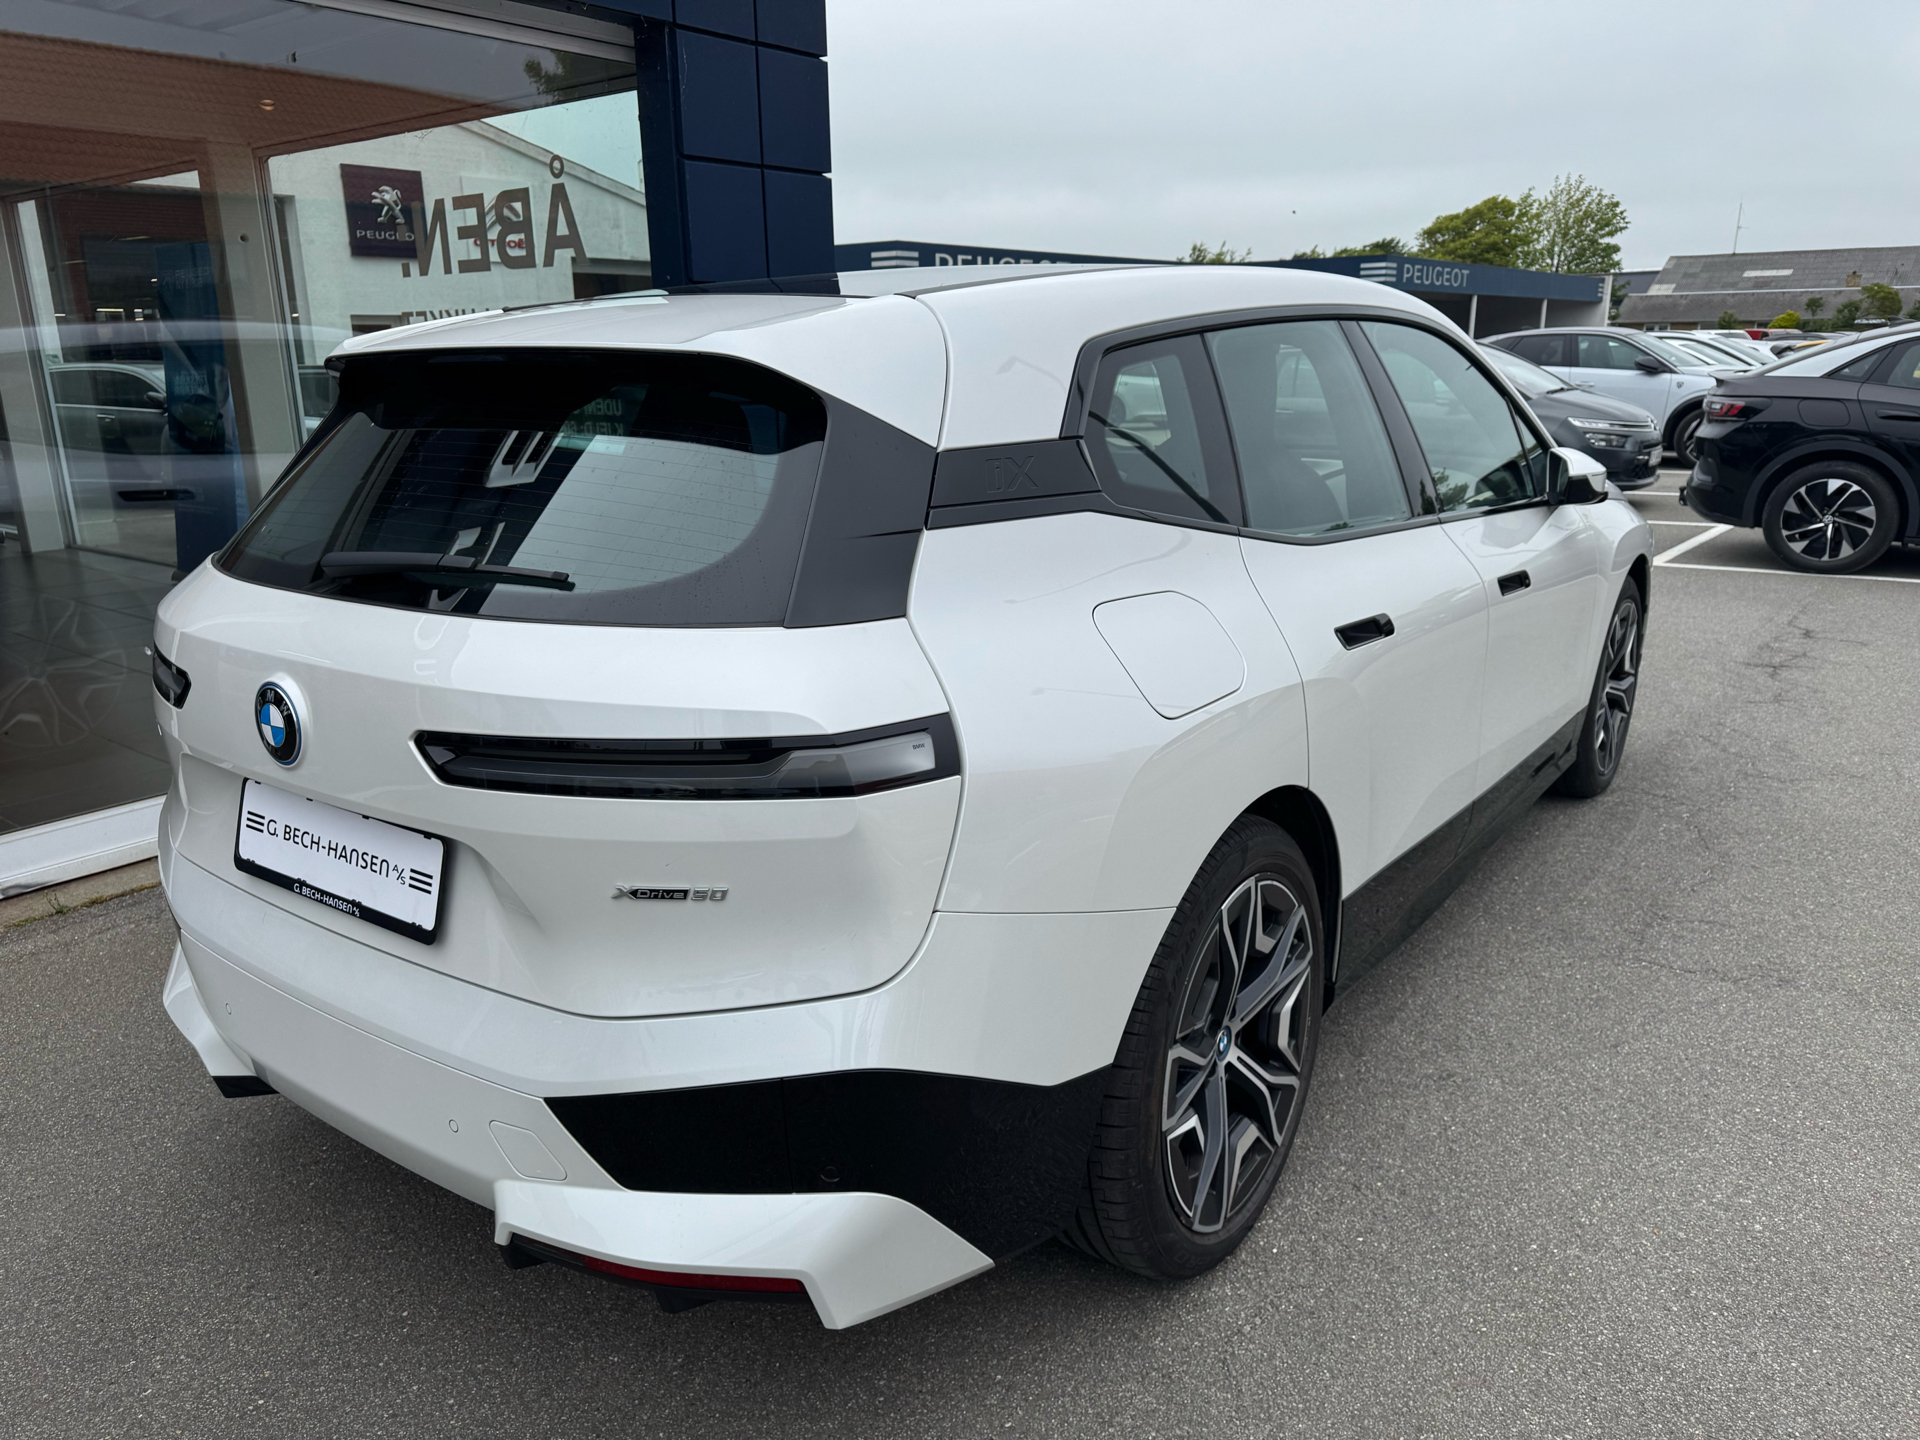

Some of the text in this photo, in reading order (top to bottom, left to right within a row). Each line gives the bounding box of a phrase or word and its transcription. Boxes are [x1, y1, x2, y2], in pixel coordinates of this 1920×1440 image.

[356, 229, 415, 242] PEUGO
[1403, 263, 1470, 288] PEUGEOT
[985, 455, 1039, 494] iX
[266, 819, 279, 838] G.
[283, 824, 390, 878] BECH-HANSEN
[293, 882, 301, 894] G.
[301, 886, 353, 914] BECH-HANSEN
[691, 887, 729, 901] 50
